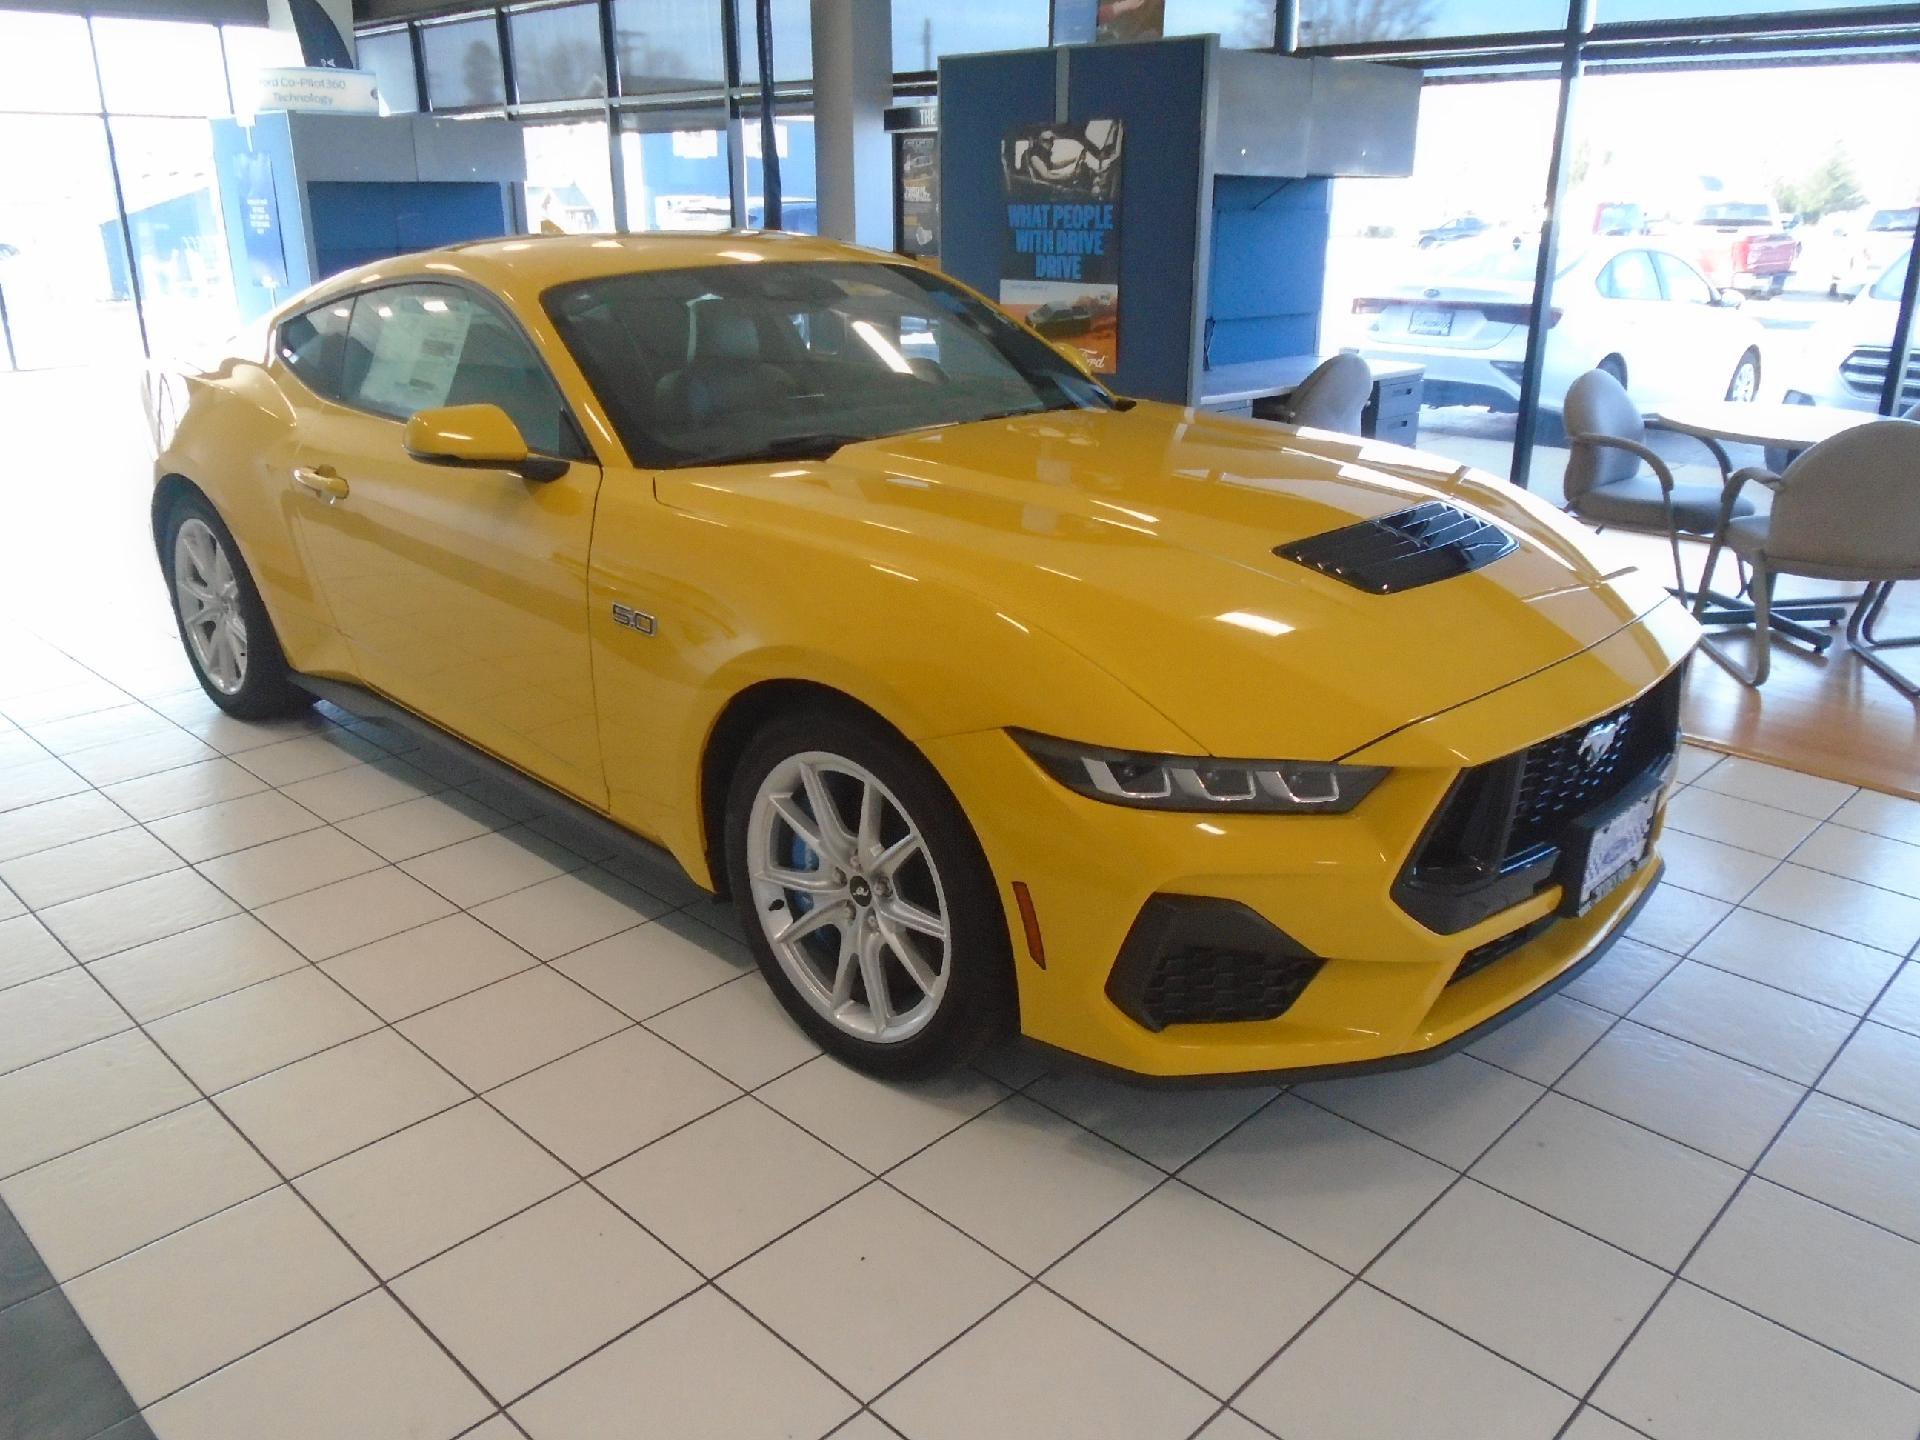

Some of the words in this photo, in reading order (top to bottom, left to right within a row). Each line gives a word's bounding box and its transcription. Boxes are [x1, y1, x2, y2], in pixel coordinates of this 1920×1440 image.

[272, 91, 334, 105] Technology
[919, 109, 937, 126] THE
[1008, 204, 1051, 229] WHAT
[1053, 204, 1114, 230] PEOPLE
[1016, 229, 1053, 253] WITH
[1056, 229, 1104, 256] DRIVE
[1036, 255, 1082, 279] DRIVE
[612, 602, 656, 636] 5.0
